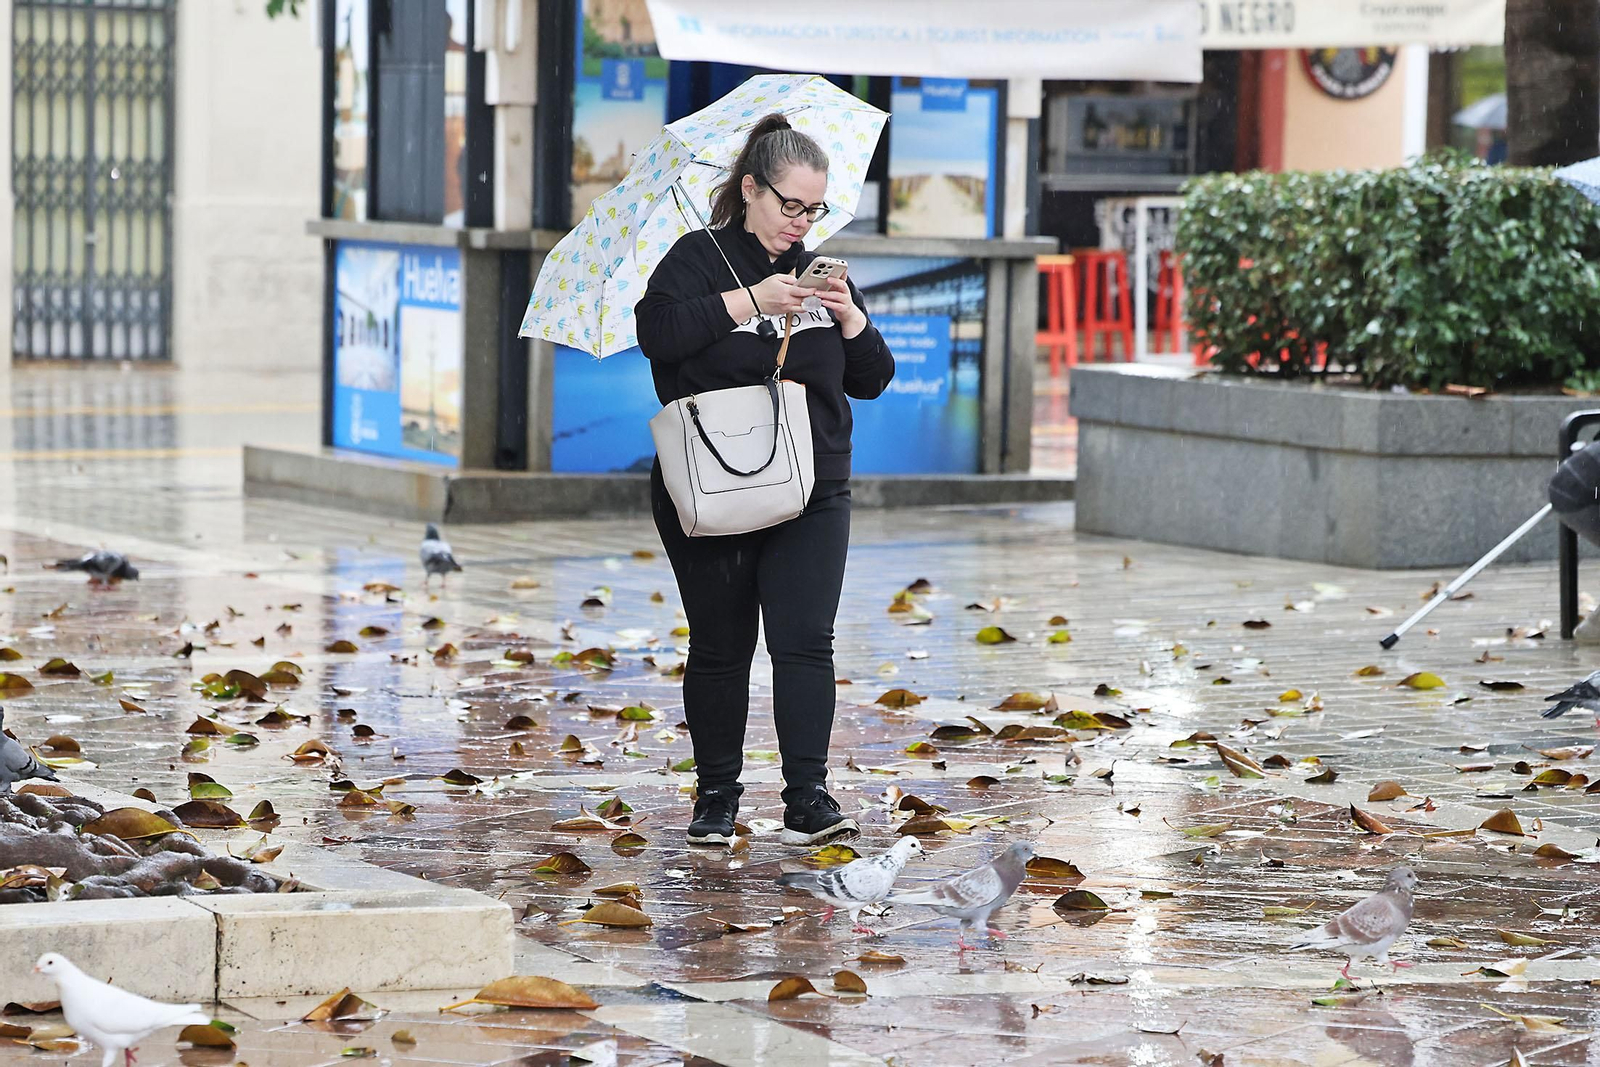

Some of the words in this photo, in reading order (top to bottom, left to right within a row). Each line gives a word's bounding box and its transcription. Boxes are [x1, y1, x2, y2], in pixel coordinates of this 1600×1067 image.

[1220, 1, 1296, 34] NEGRO
[993, 27, 1100, 44] INFORMATION
[403, 253, 461, 304] Huelva
